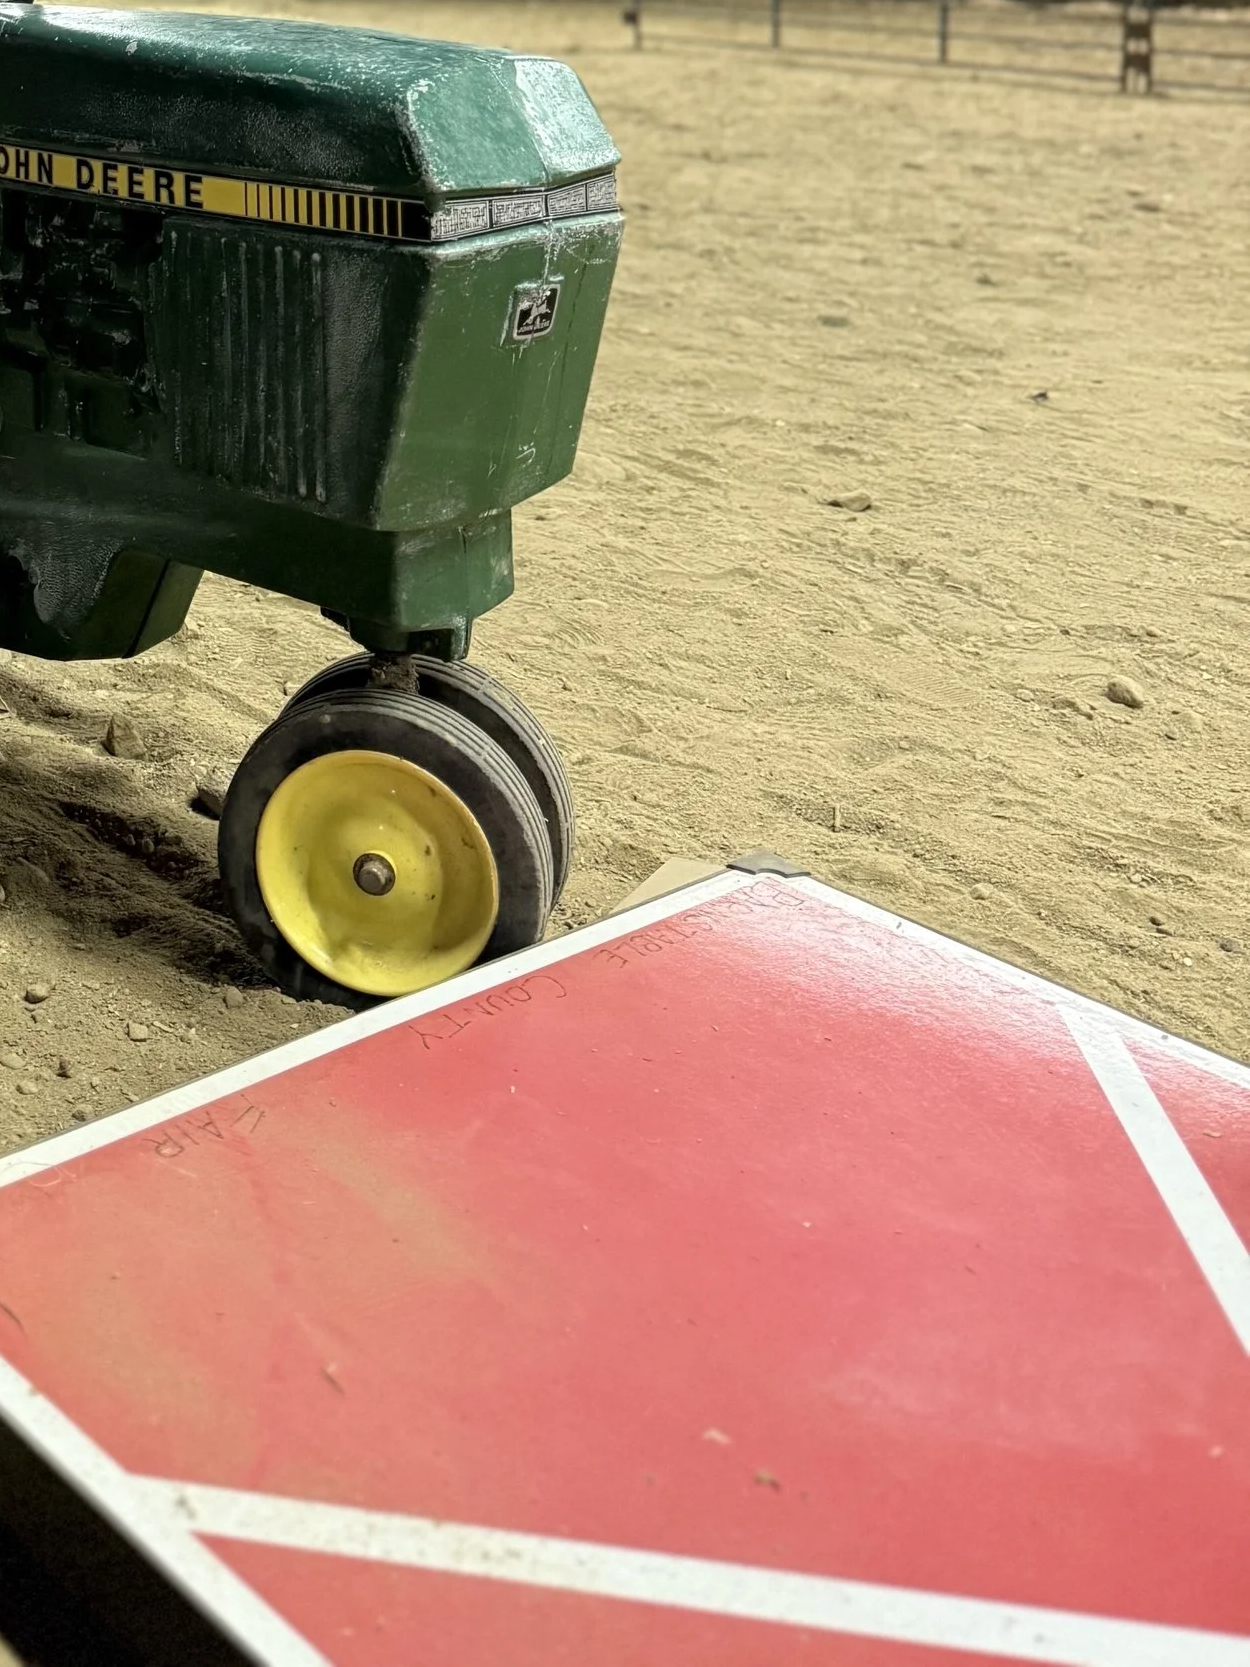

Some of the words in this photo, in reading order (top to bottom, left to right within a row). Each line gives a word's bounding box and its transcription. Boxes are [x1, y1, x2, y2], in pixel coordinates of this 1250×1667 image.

[76, 157, 203, 209] DEERE
[595, 881, 804, 968] BARNSTABLE
[408, 976, 566, 1049] COUNTY
[141, 1094, 267, 1159] FAIR
